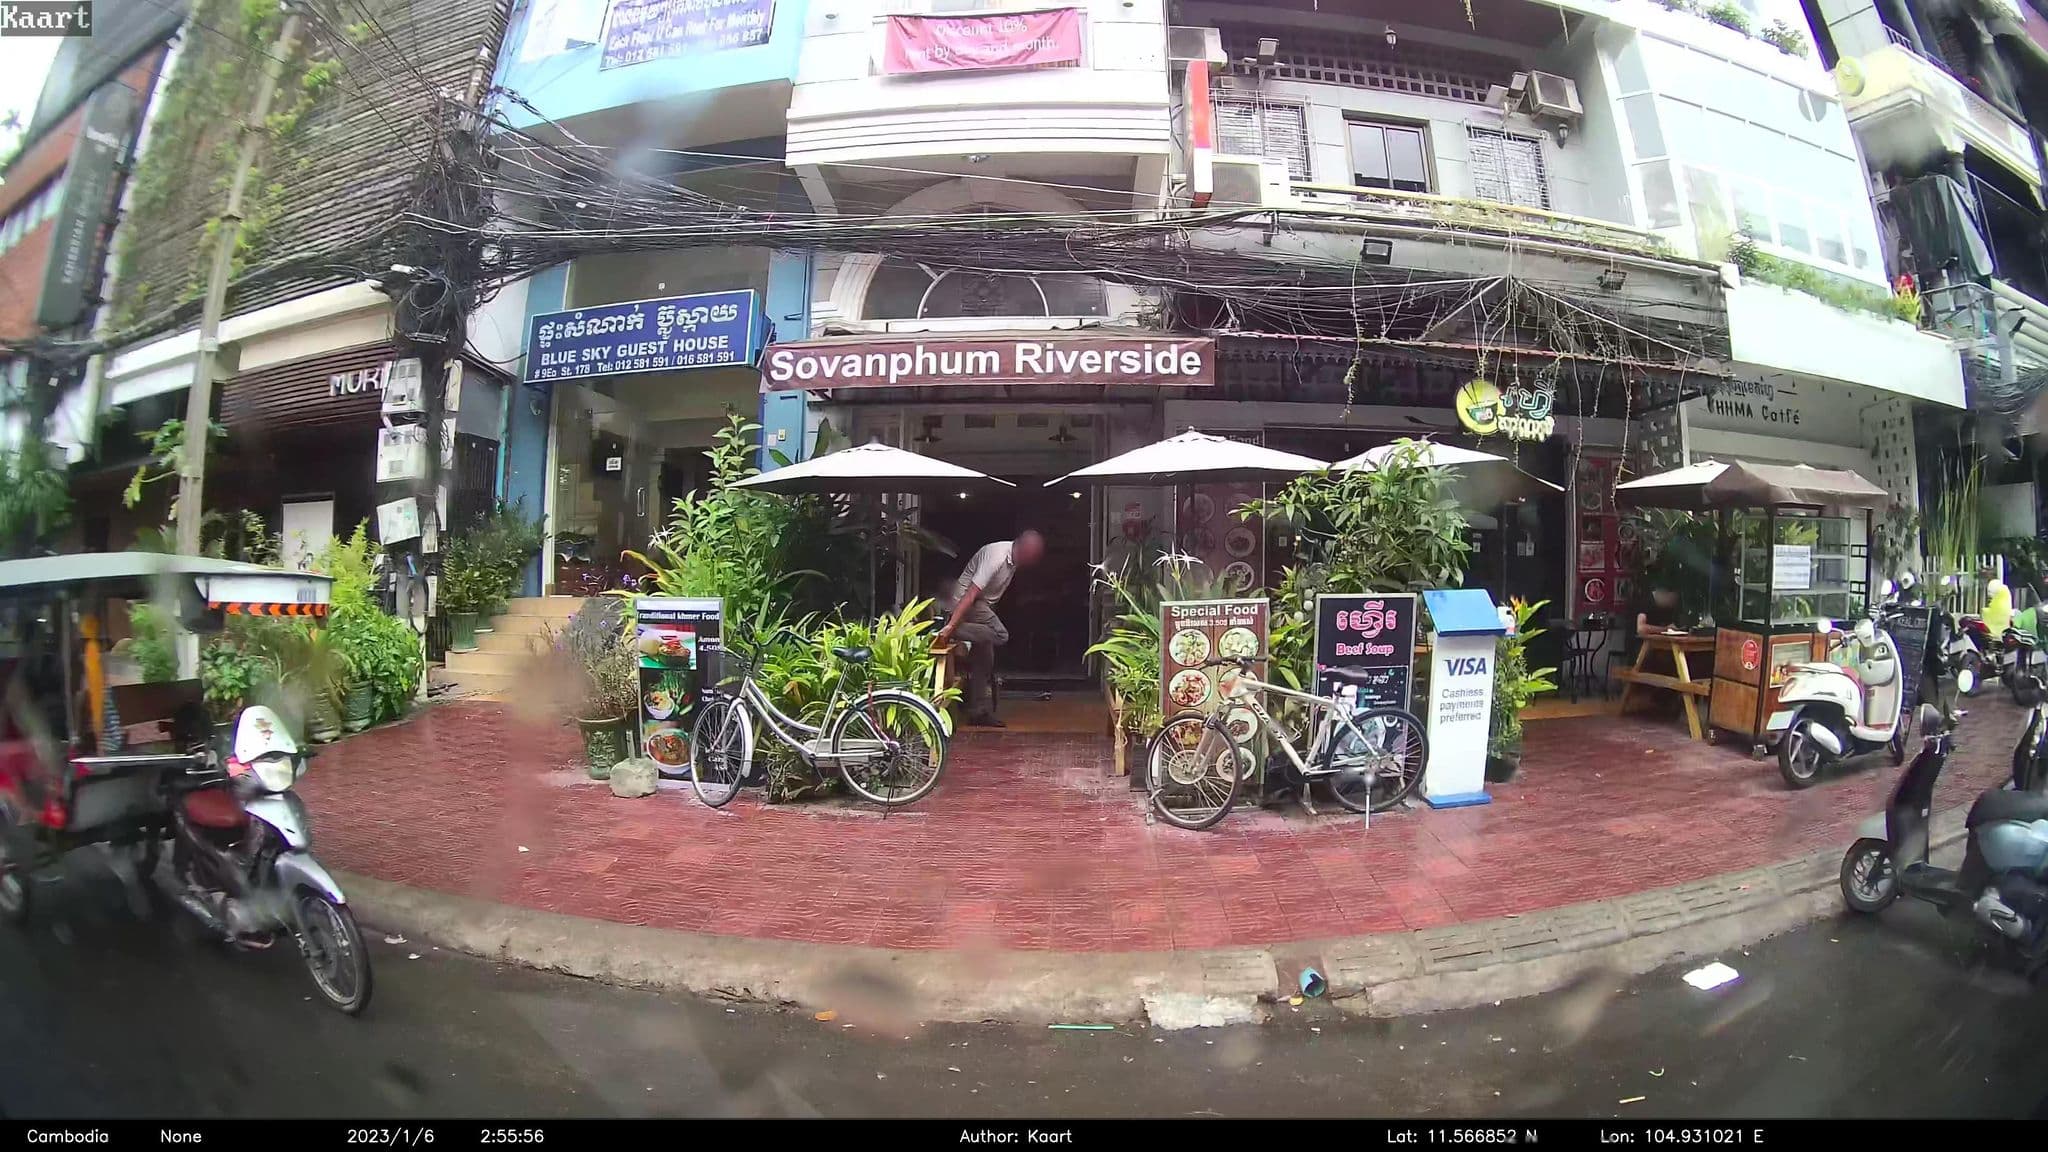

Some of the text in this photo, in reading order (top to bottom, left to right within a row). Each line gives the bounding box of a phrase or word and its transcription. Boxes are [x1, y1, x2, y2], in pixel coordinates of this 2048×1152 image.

[541, 335, 729, 366] BLUE SKY GUEST HOUSE
[575, 363, 591, 375] 178
[597, 361, 614, 373] Tel:
[615, 359, 632, 371] 012
[633, 357, 650, 369] 581
[652, 355, 669, 368] 591
[676, 353, 695, 366] 016
[696, 352, 714, 364] 581
[716, 350, 735, 362] 591
[770, 342, 1202, 384] Sovanphum Riverside
[701, 612, 720, 620] Food
[1171, 603, 1259, 620] Special Food
[1336, 642, 1394, 657] Beef Soup
[1443, 657, 1487, 676] VISA
[1441, 688, 1485, 699] Cashless
[1440, 700, 1484, 712] payments
[1440, 712, 1482, 725] preferred
